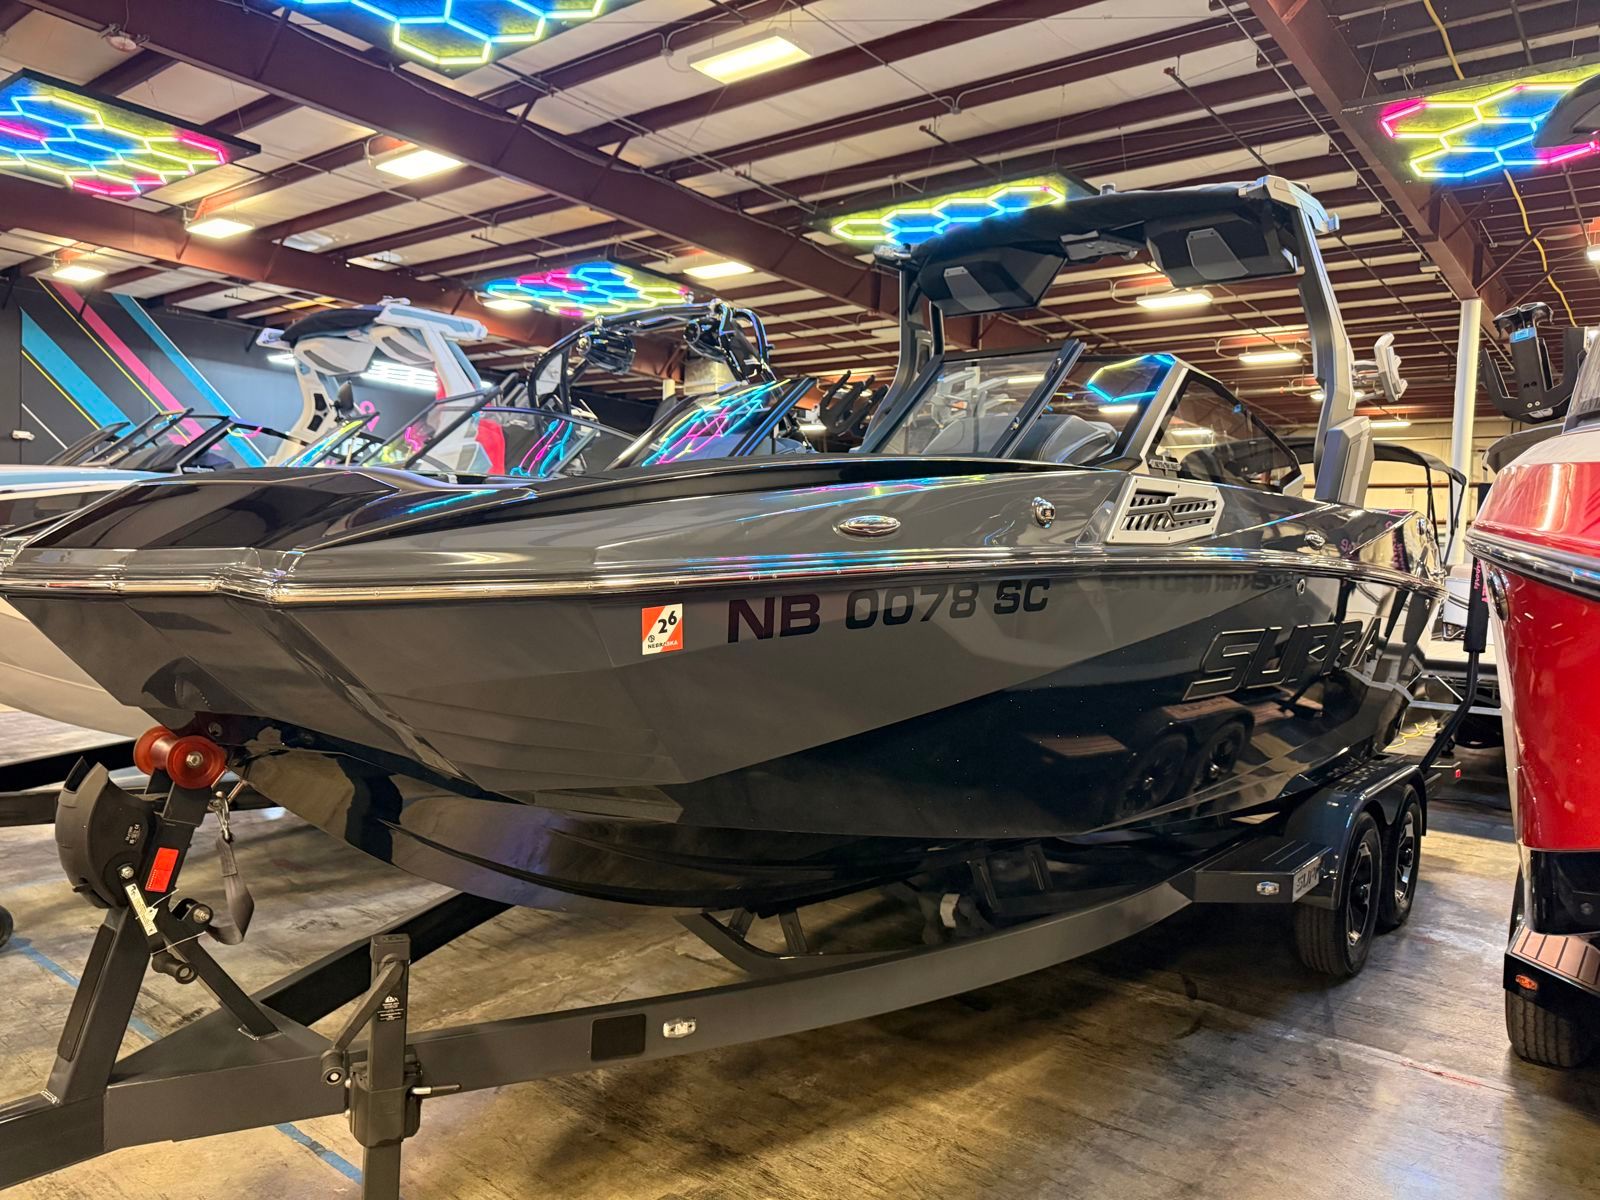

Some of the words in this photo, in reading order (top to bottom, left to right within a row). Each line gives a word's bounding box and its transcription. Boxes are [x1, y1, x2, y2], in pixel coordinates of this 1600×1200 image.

[657, 610, 677, 634] 26
[728, 594, 821, 643] NB
[846, 583, 979, 630] 0078
[994, 578, 1050, 614] SC
[647, 640, 678, 649] NEBRASKA
[1183, 617, 1381, 700] SUPRA
